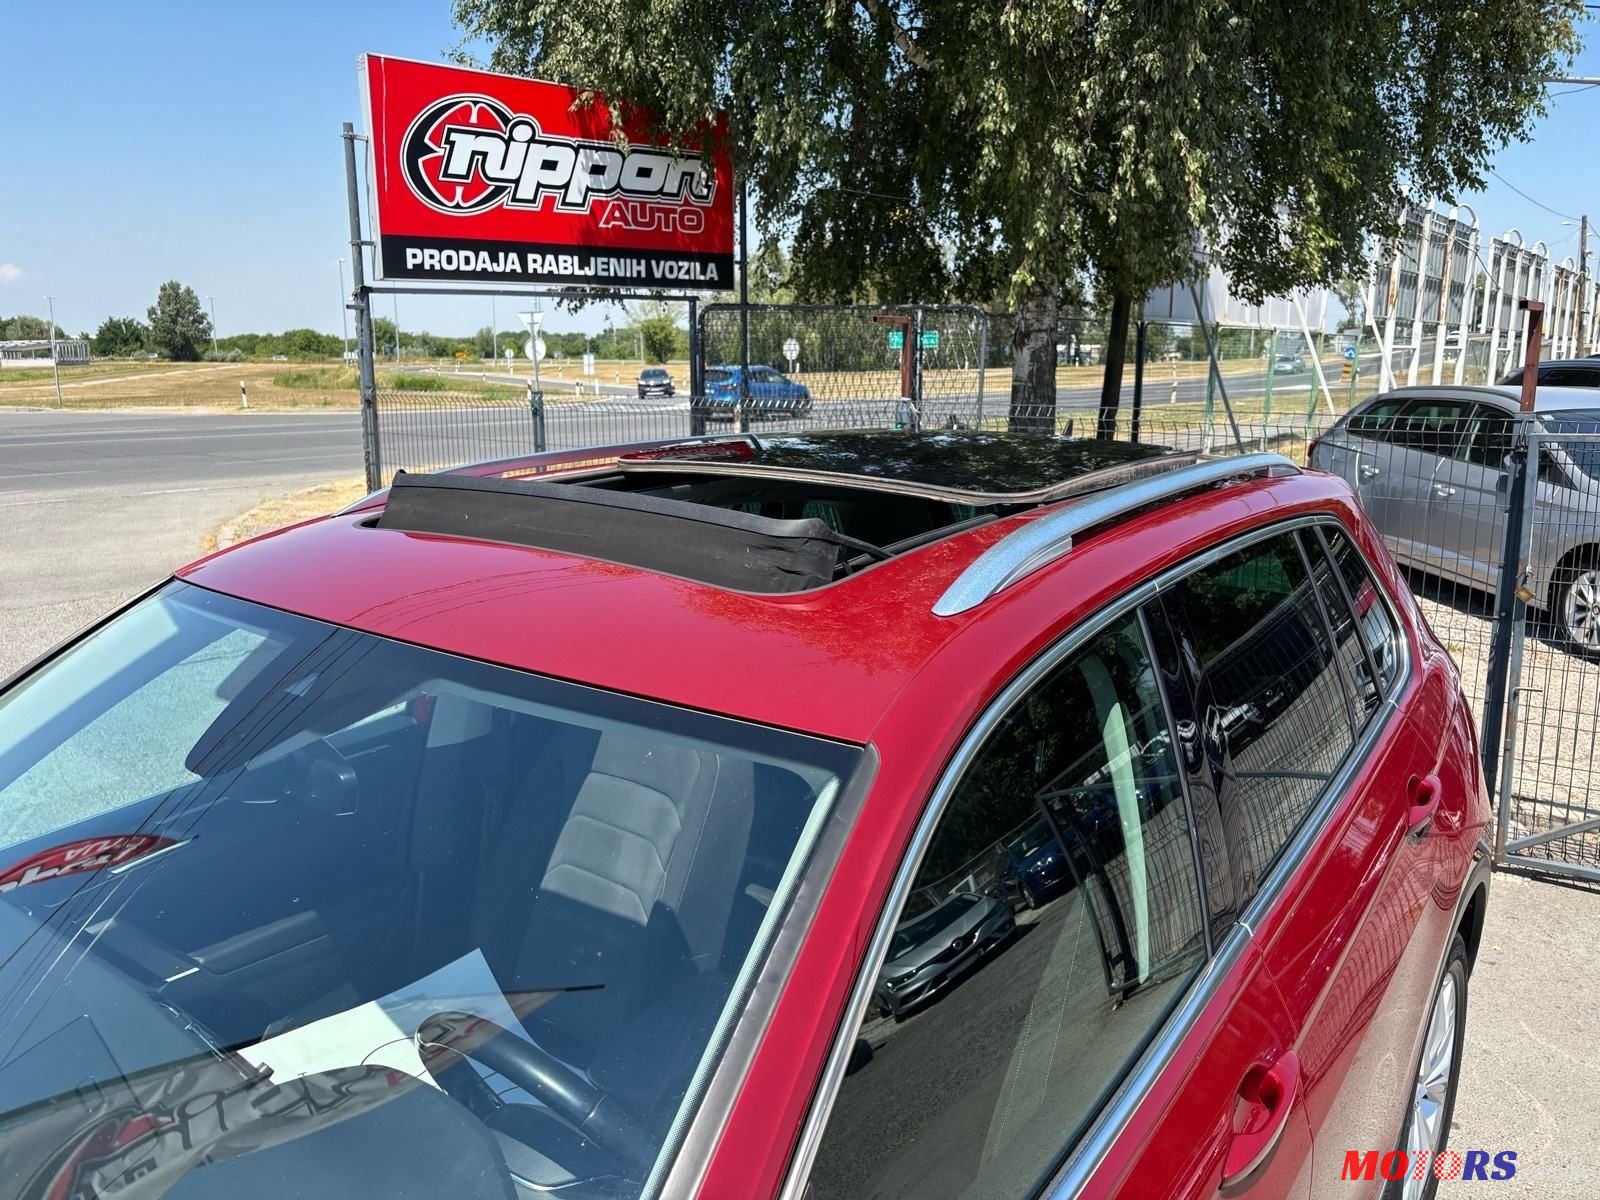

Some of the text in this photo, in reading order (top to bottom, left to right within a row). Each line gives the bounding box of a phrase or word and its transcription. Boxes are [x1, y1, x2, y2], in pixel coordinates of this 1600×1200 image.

[442, 118, 714, 209] nippon
[598, 201, 705, 234] AUTO
[405, 247, 719, 281] PRODAJA RABLJENIH VOZILA
